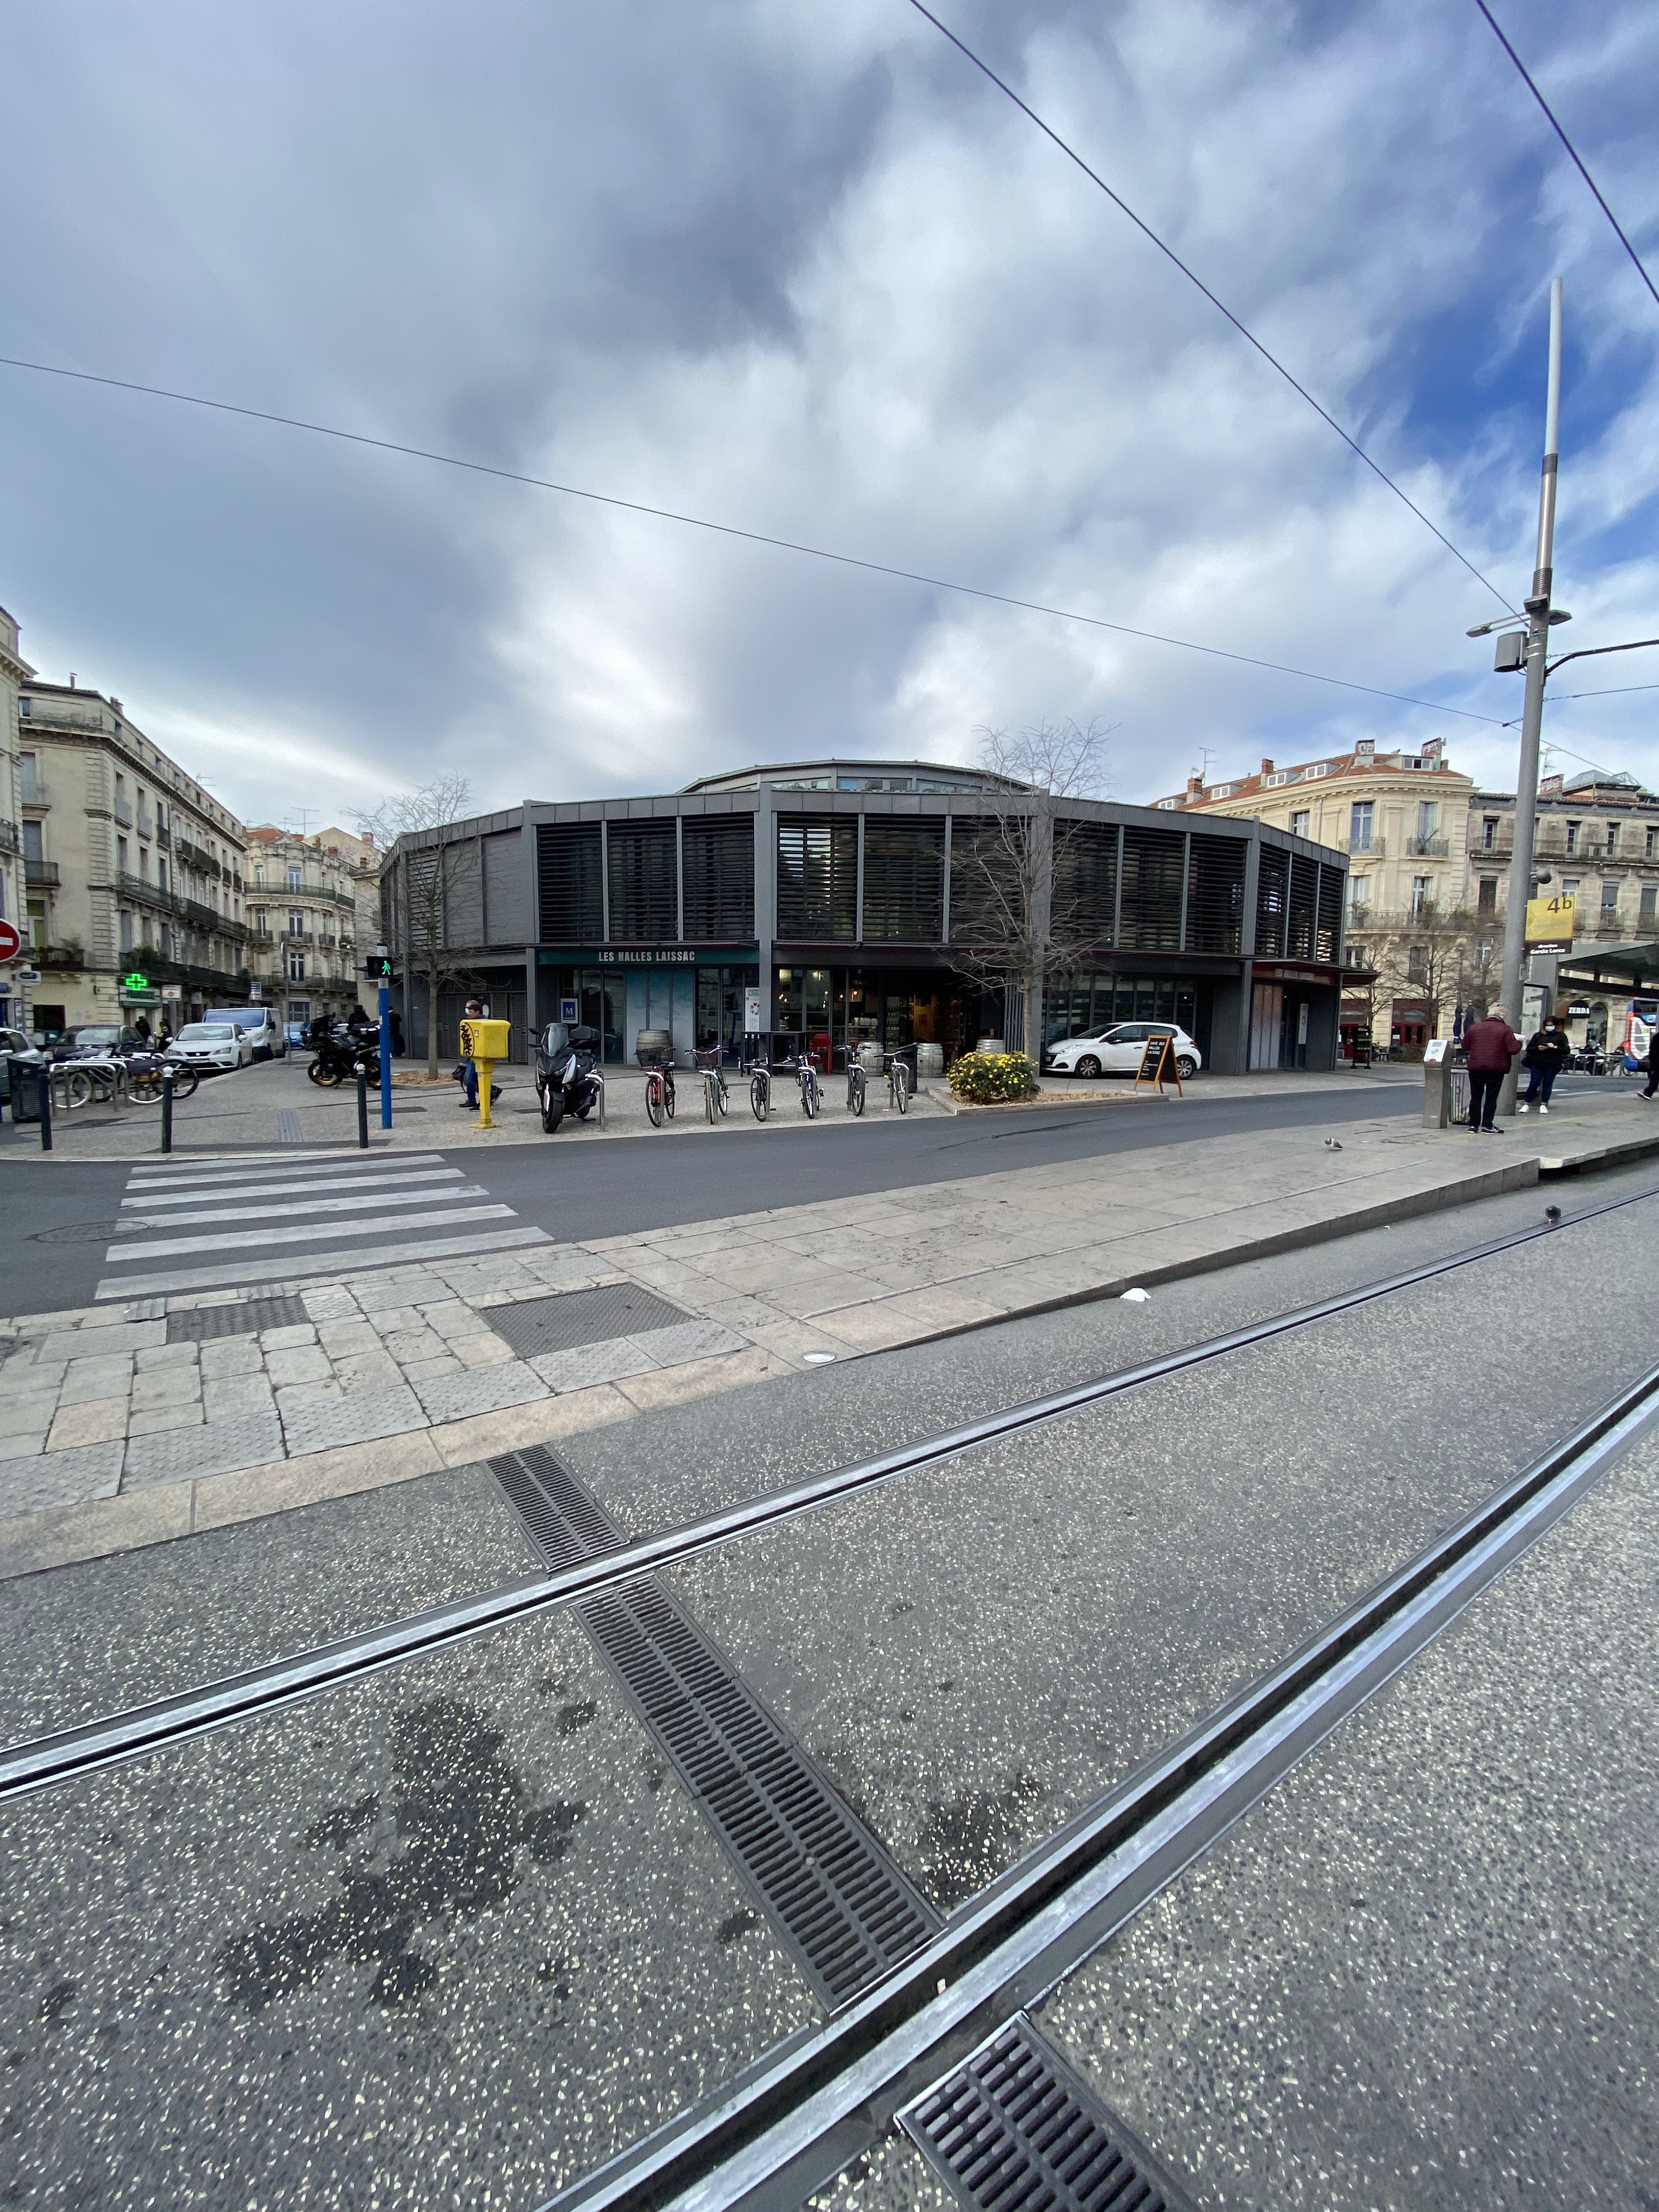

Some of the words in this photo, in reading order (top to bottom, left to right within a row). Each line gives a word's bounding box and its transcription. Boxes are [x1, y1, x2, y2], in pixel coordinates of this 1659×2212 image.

[599, 952, 614, 962] LES
[618, 952, 652, 962] HALLES
[656, 951, 695, 961] LAISSAC
